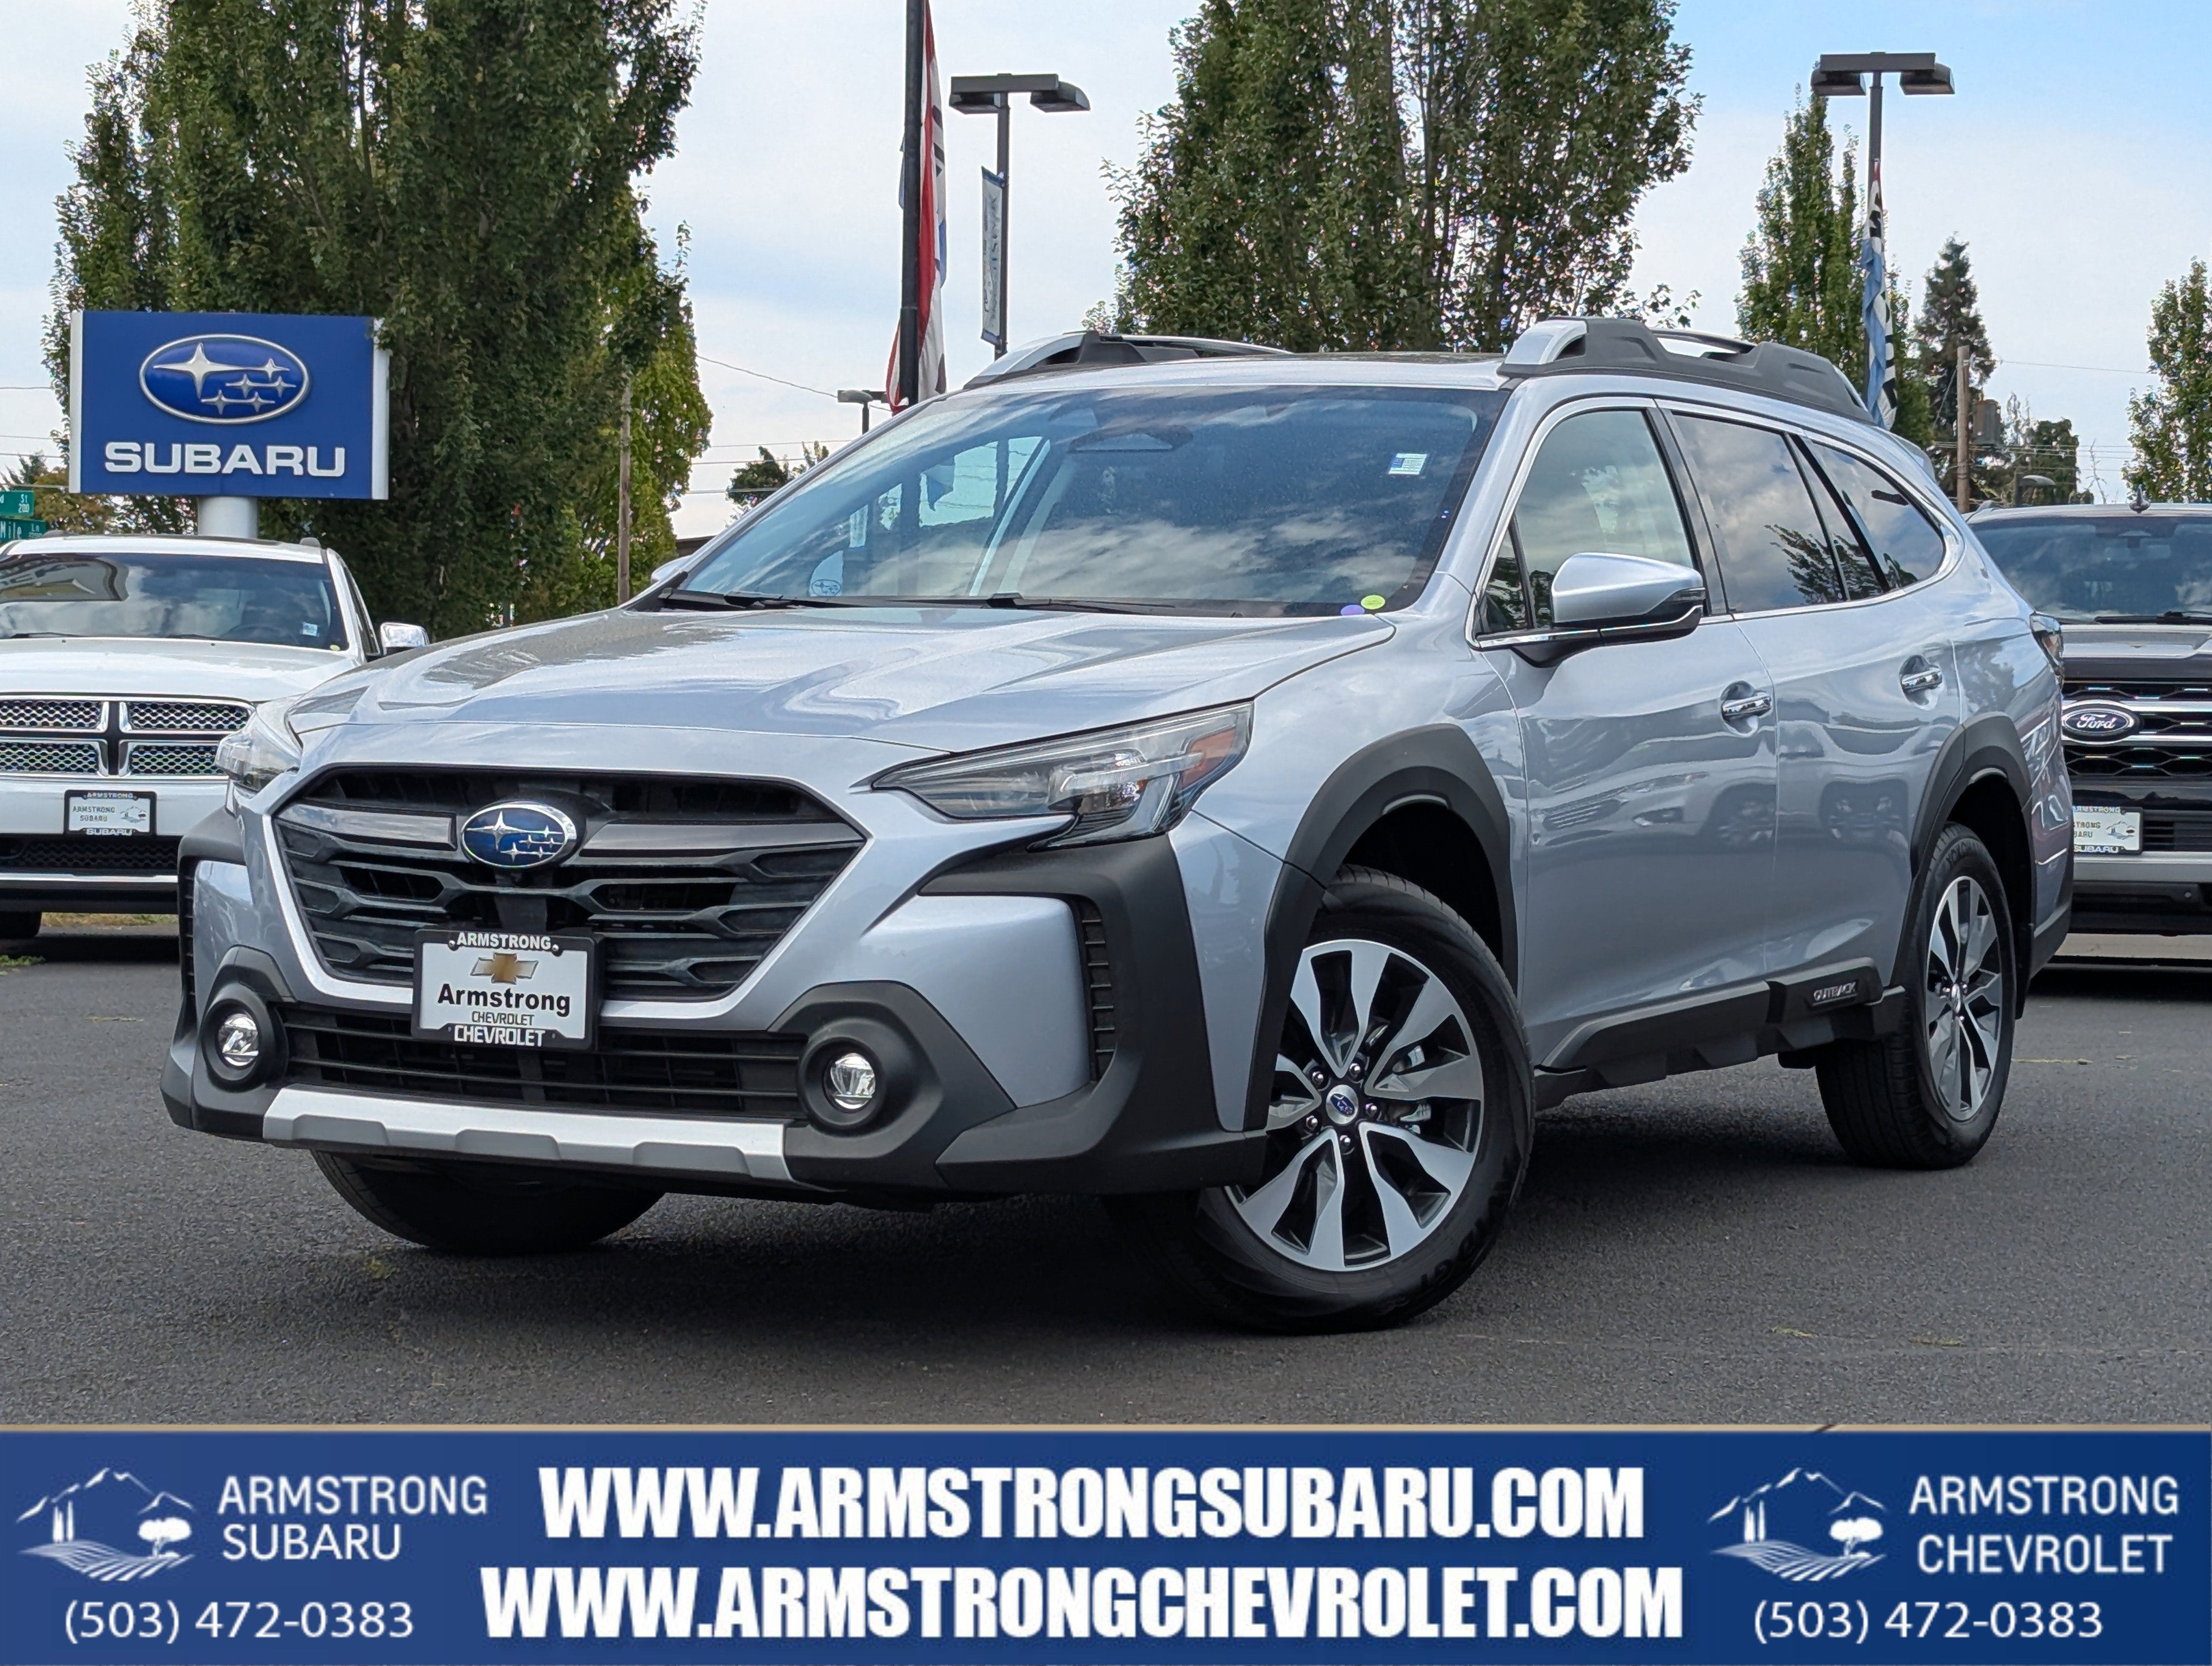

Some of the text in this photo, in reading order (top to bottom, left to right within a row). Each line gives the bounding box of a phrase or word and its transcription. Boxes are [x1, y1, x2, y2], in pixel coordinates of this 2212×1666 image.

[105, 441, 345, 477] SUBARU
[2076, 713, 2117, 728] Ford
[456, 932, 550, 950] ARMSTRONG
[438, 983, 570, 1017] Armstrong
[1814, 981, 1856, 1001] OUTBACK
[472, 1010, 535, 1026] CHEVROLET
[454, 1025, 545, 1047] CHEVROLET
